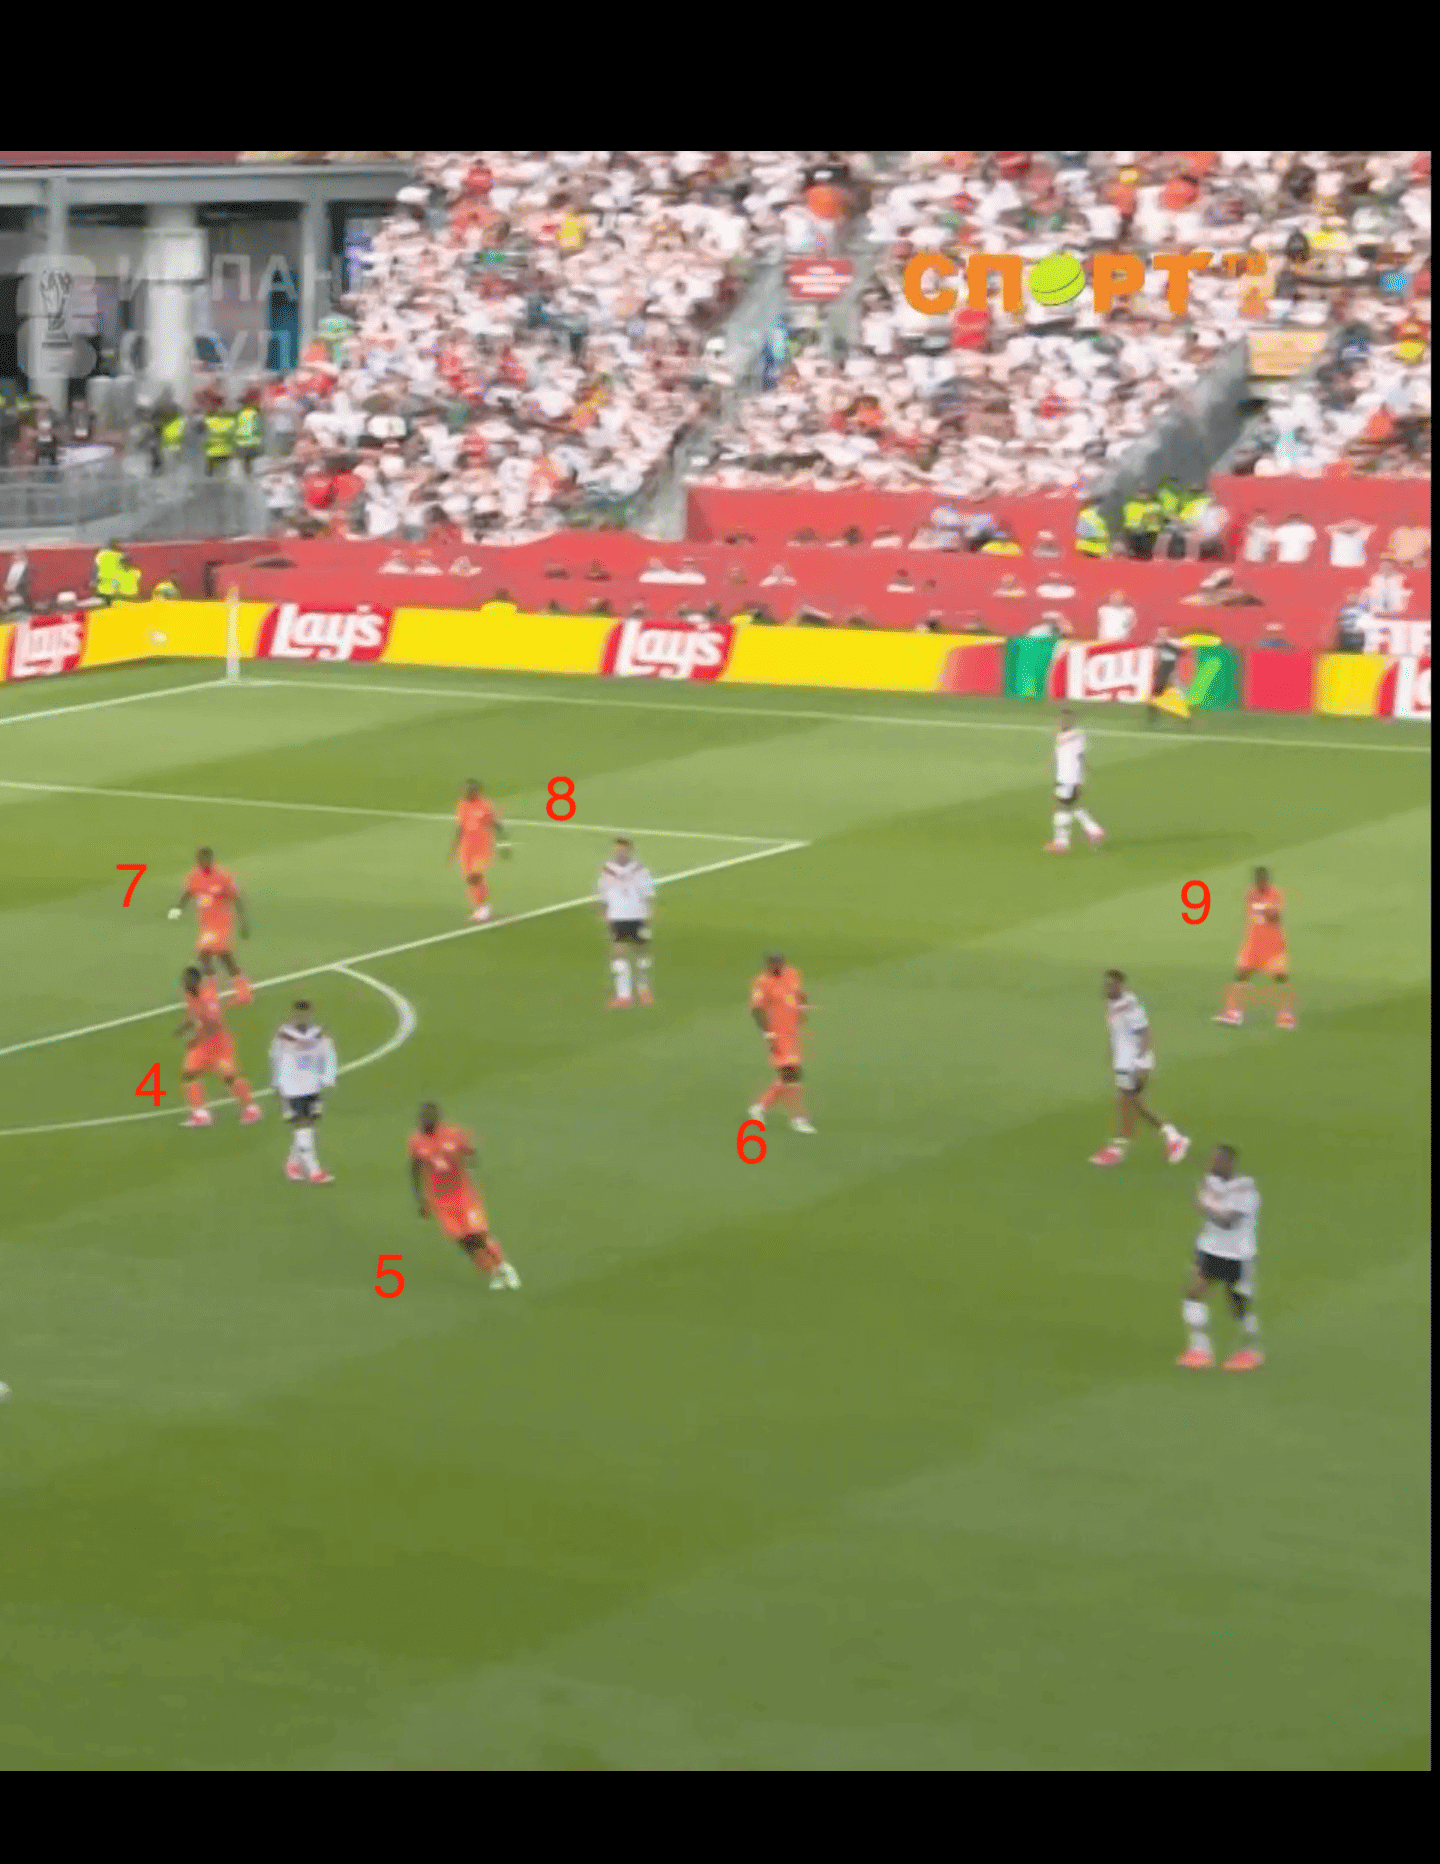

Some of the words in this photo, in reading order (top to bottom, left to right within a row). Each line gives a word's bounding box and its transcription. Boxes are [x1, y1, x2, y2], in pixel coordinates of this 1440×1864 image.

[269, 602, 385, 661] Lay's
[614, 617, 725, 679] Lay's
[1066, 645, 1155, 701] Lay
